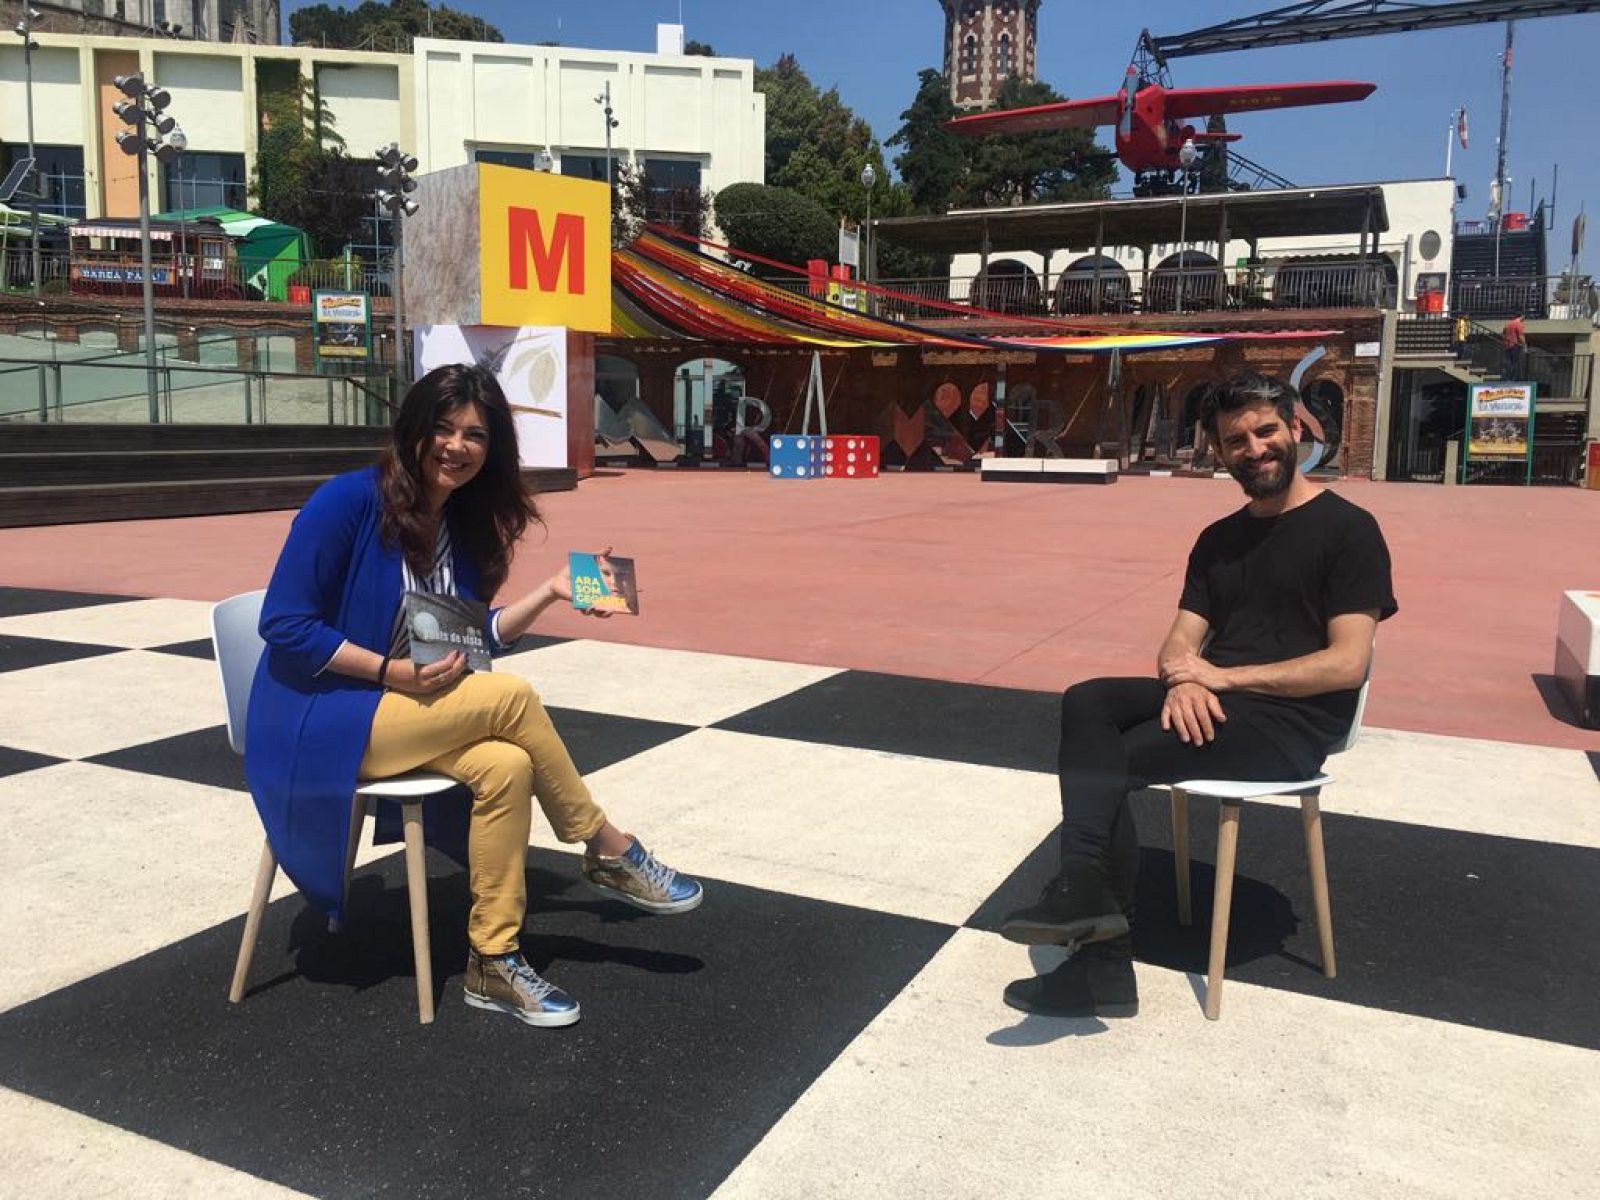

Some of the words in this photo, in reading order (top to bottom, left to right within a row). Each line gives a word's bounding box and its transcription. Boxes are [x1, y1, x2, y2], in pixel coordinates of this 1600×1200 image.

[508, 206, 584, 295] M
[575, 576, 600, 588] ARA
[575, 585, 601, 595] SOM
[462, 634, 482, 646] vista
